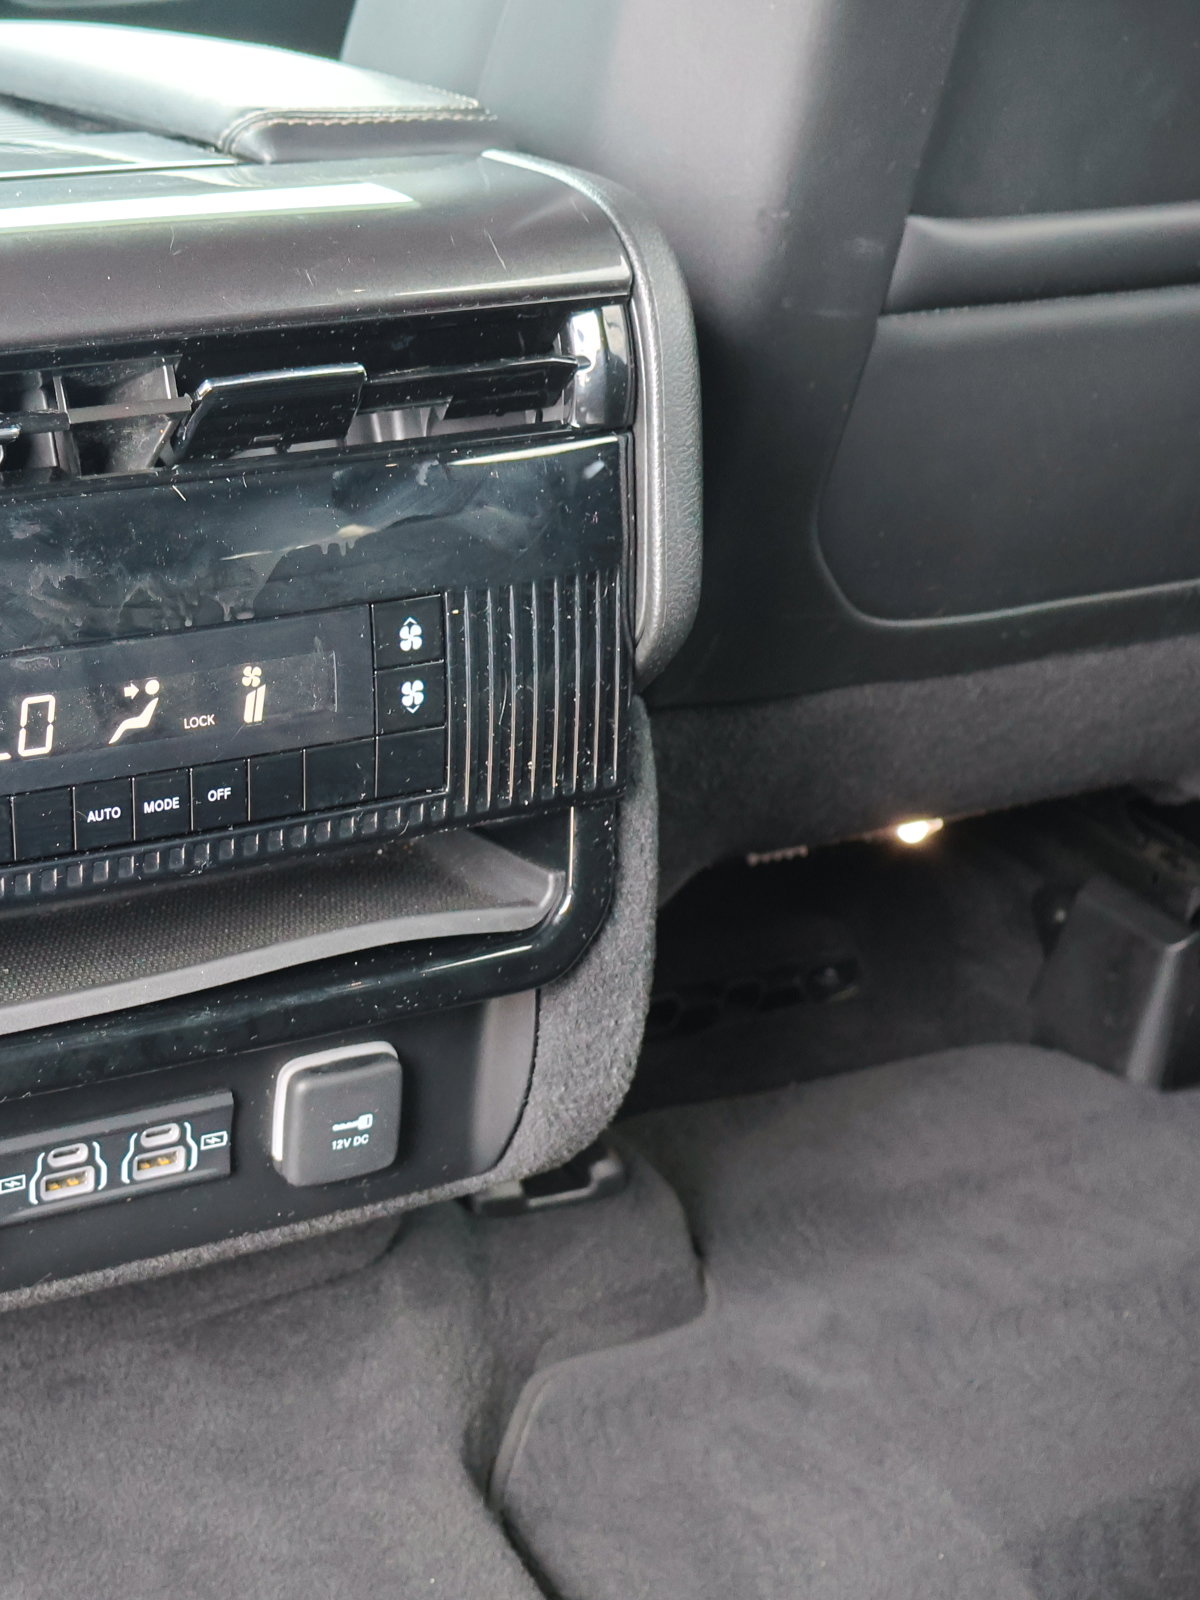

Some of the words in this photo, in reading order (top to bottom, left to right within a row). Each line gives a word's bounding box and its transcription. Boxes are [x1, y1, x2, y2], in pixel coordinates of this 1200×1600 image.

[184, 714, 215, 729] LOCK
[207, 786, 232, 801] OFF
[143, 796, 180, 813] MODE
[86, 806, 121, 823] AUTO
[332, 1137, 351, 1150] 12V
[353, 1134, 369, 1147] DC
